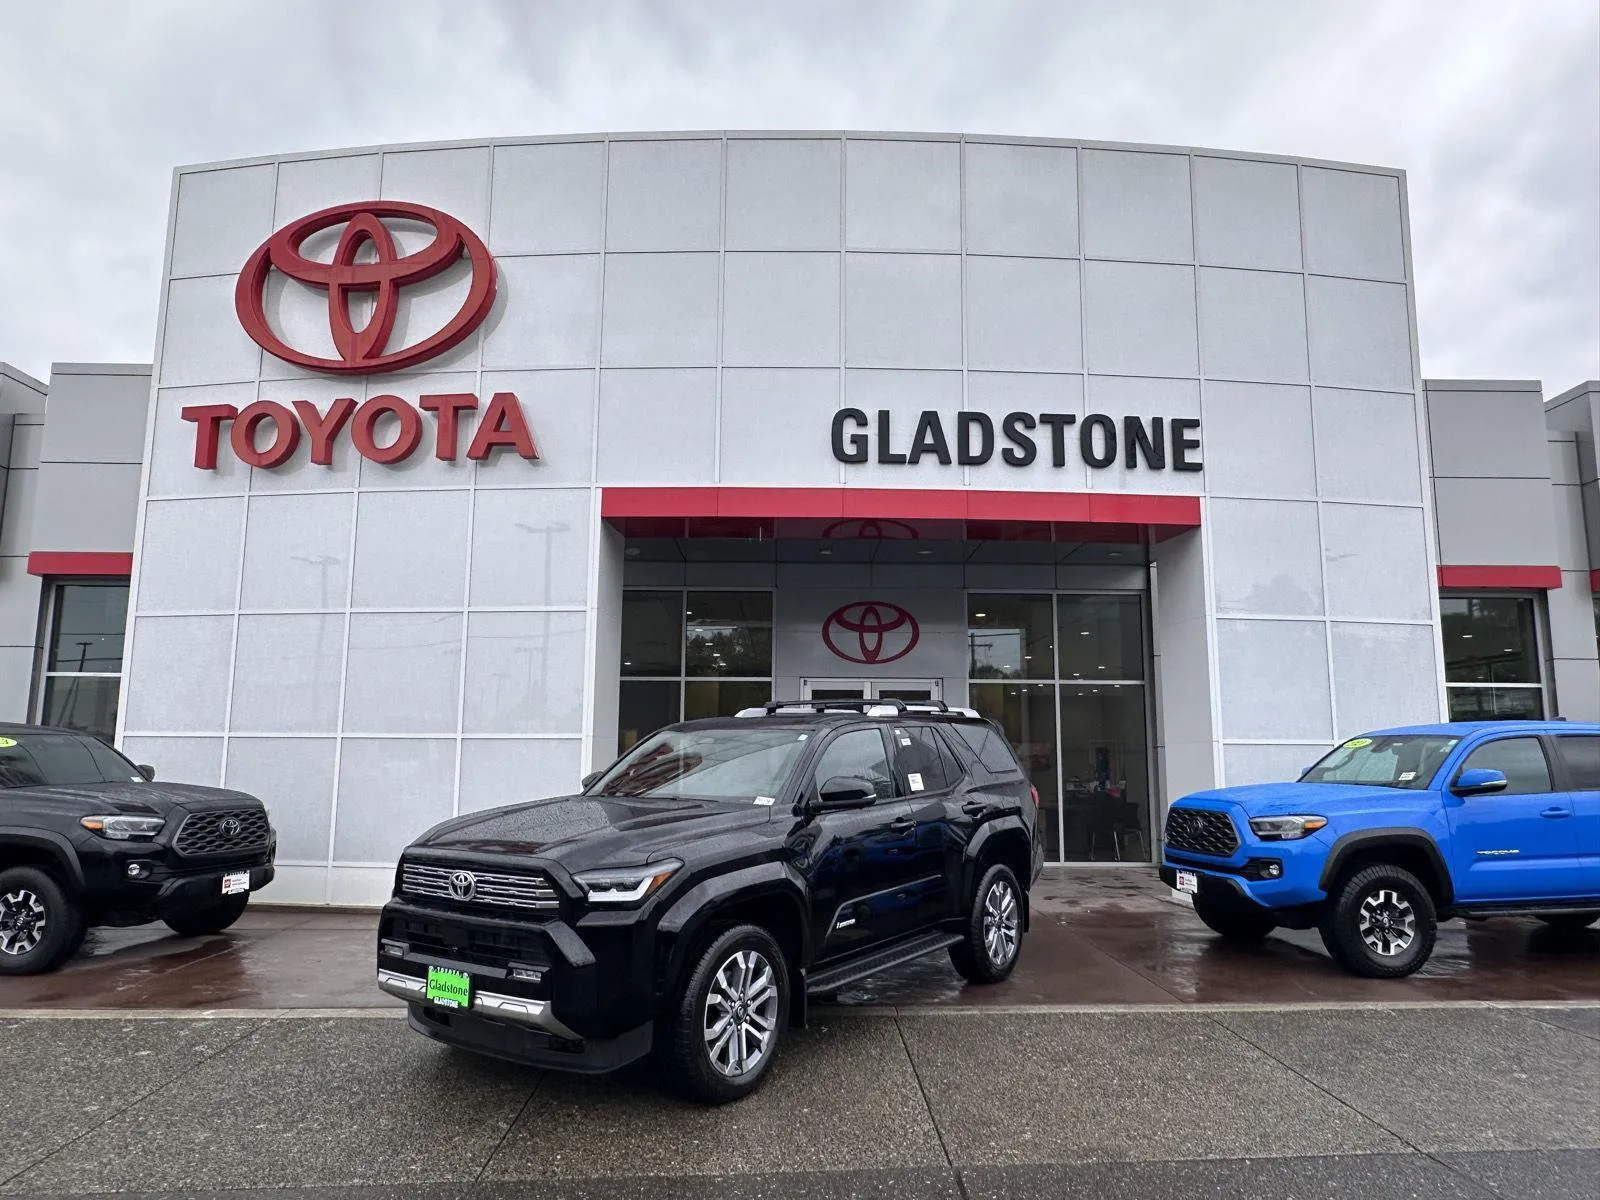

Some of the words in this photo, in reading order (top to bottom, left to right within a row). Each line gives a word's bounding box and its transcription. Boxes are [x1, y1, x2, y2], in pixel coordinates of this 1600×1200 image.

[181, 392, 540, 470] TOYOTA
[831, 407, 1203, 472] GLADSTONE
[429, 979, 468, 997] Gladstone
